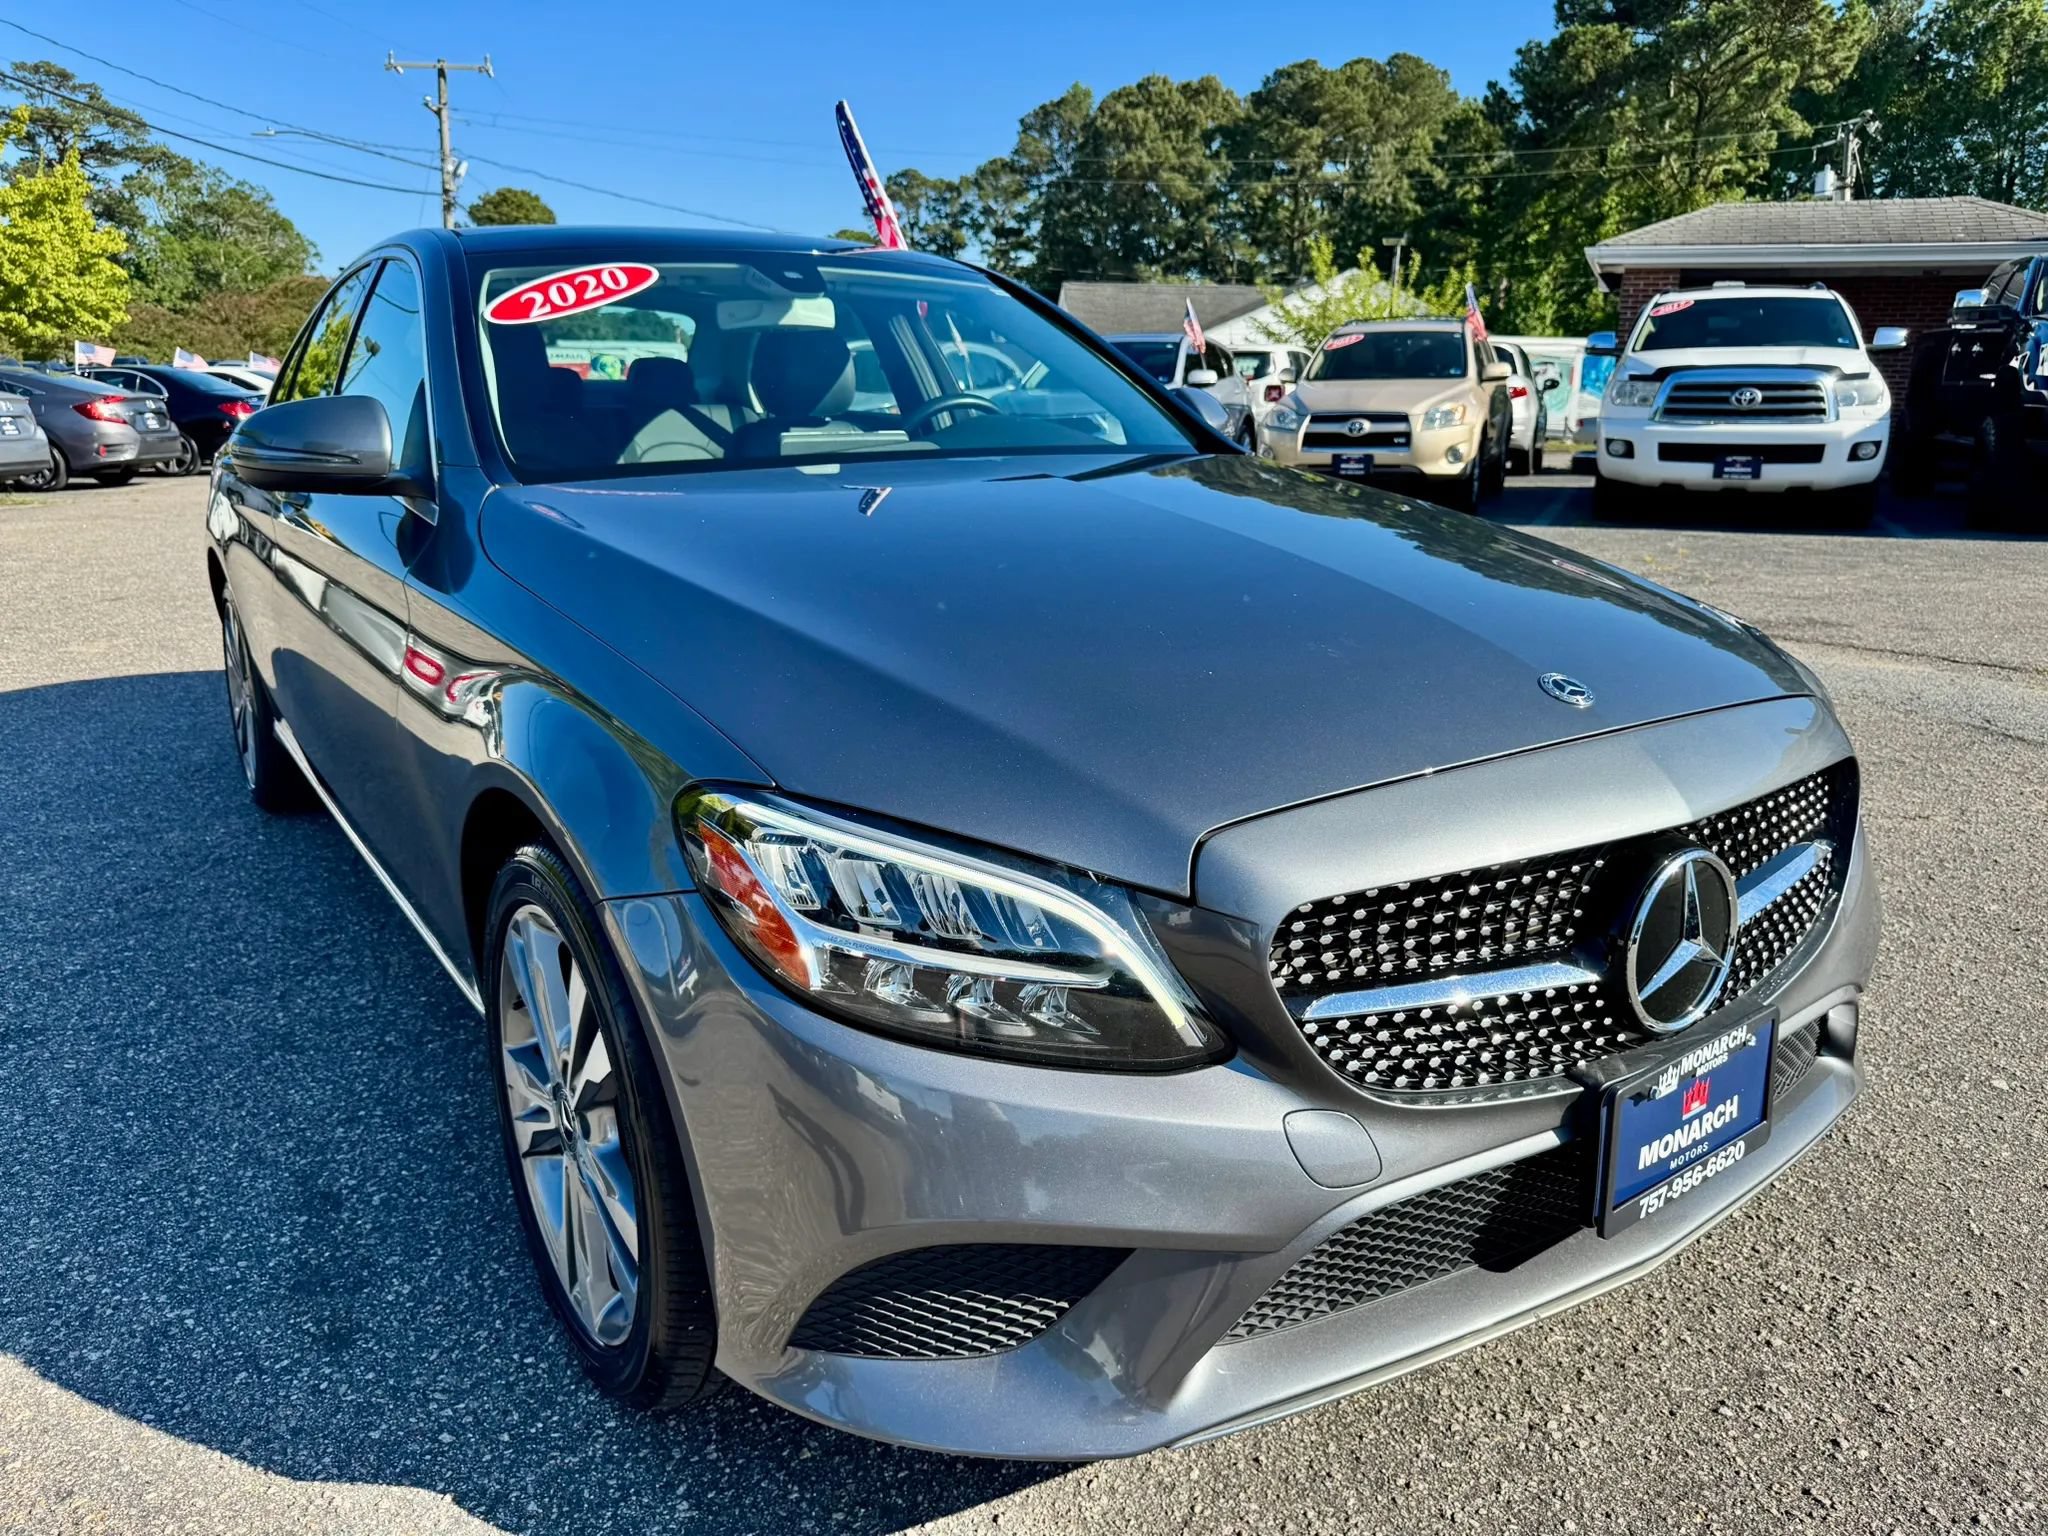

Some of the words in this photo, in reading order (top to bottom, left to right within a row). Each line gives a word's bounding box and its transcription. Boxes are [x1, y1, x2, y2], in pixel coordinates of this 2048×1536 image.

[520, 267, 629, 318] 2020
[1680, 1024, 1748, 1076] MONARCH
[1696, 1052, 1728, 1077] MOTORS
[1638, 1095, 1739, 1170] MONARCH
[1669, 1141, 1709, 1170] MOTORS
[1639, 1140, 1746, 1220] 757-956-6620
